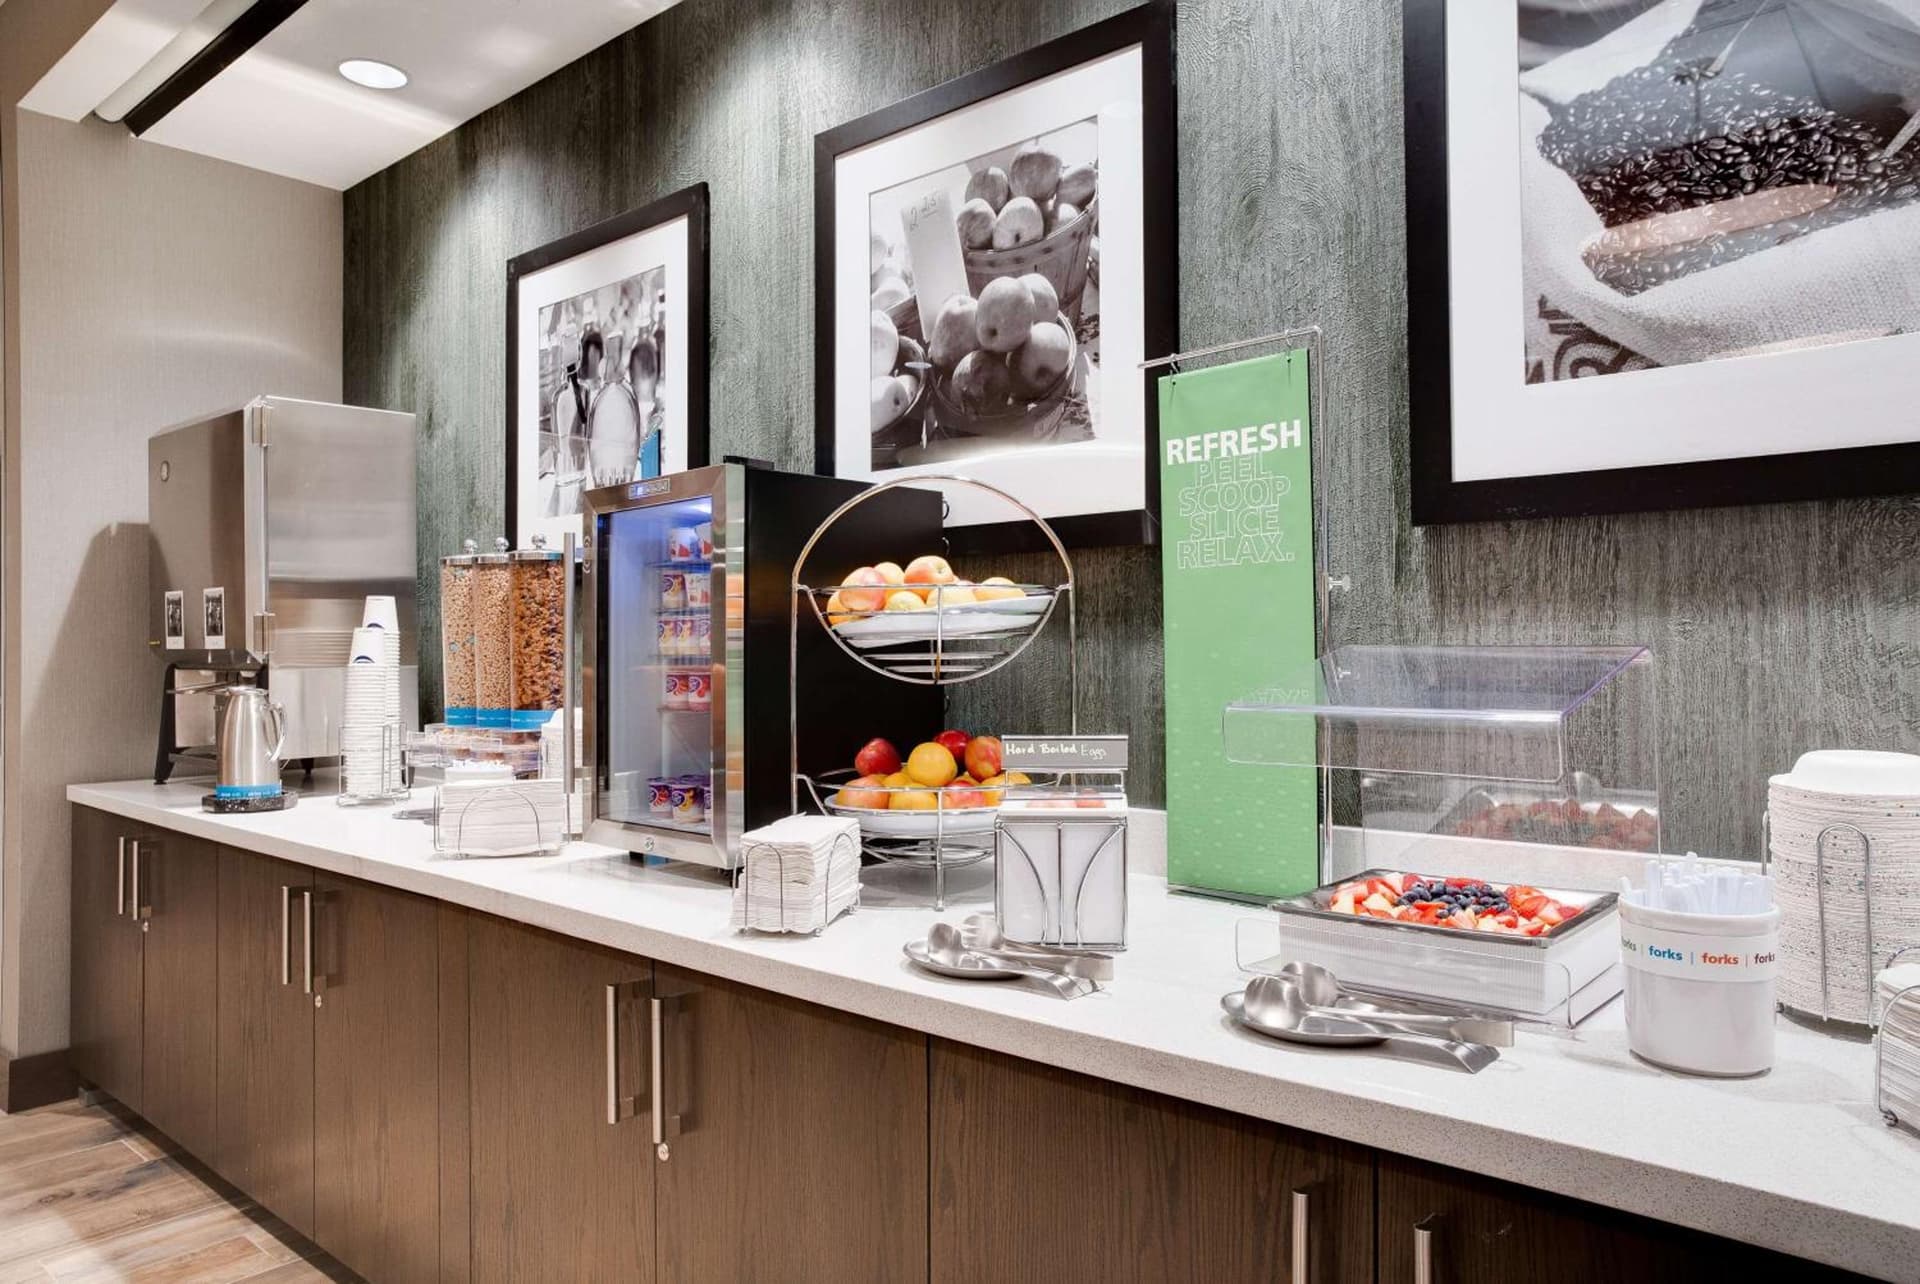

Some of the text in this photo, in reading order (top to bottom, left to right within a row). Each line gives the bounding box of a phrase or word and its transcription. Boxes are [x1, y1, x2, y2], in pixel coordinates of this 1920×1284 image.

[1166, 419, 1301, 465] REFRESH
[1195, 452, 1273, 486] PEEL
[1179, 476, 1291, 517] SCOOP
[1191, 506, 1280, 543] SLICE
[1177, 532, 1296, 569] RELAX.
[1006, 743, 1107, 760] Hard Boiled Eggs
[1648, 945, 1683, 961] forks
[1702, 952, 1739, 965] forks
